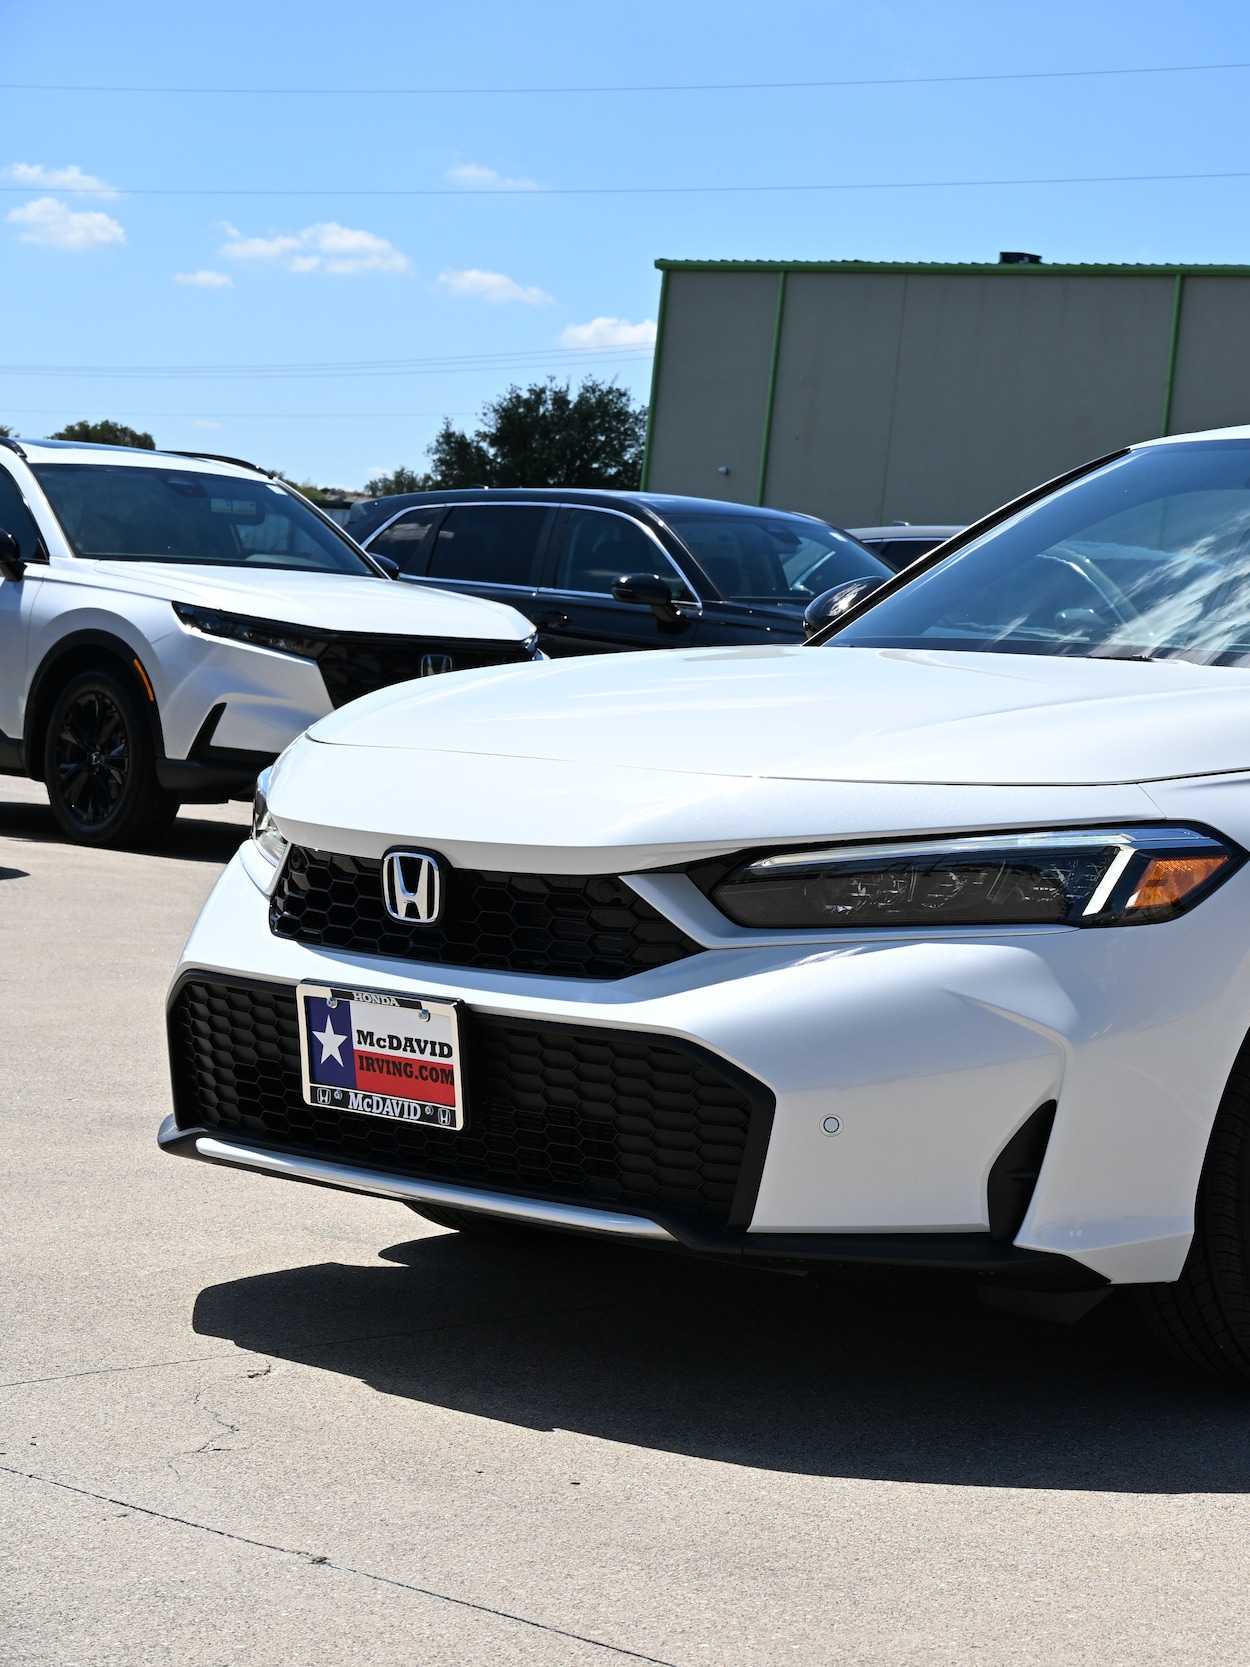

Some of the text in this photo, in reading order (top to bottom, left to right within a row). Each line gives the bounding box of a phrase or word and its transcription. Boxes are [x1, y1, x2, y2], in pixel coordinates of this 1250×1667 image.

[352, 992, 401, 1007] HONDA
[356, 1029, 453, 1059] McDAVID
[358, 1055, 454, 1086] IRVING.COM
[348, 1092, 422, 1120] McDAVID
